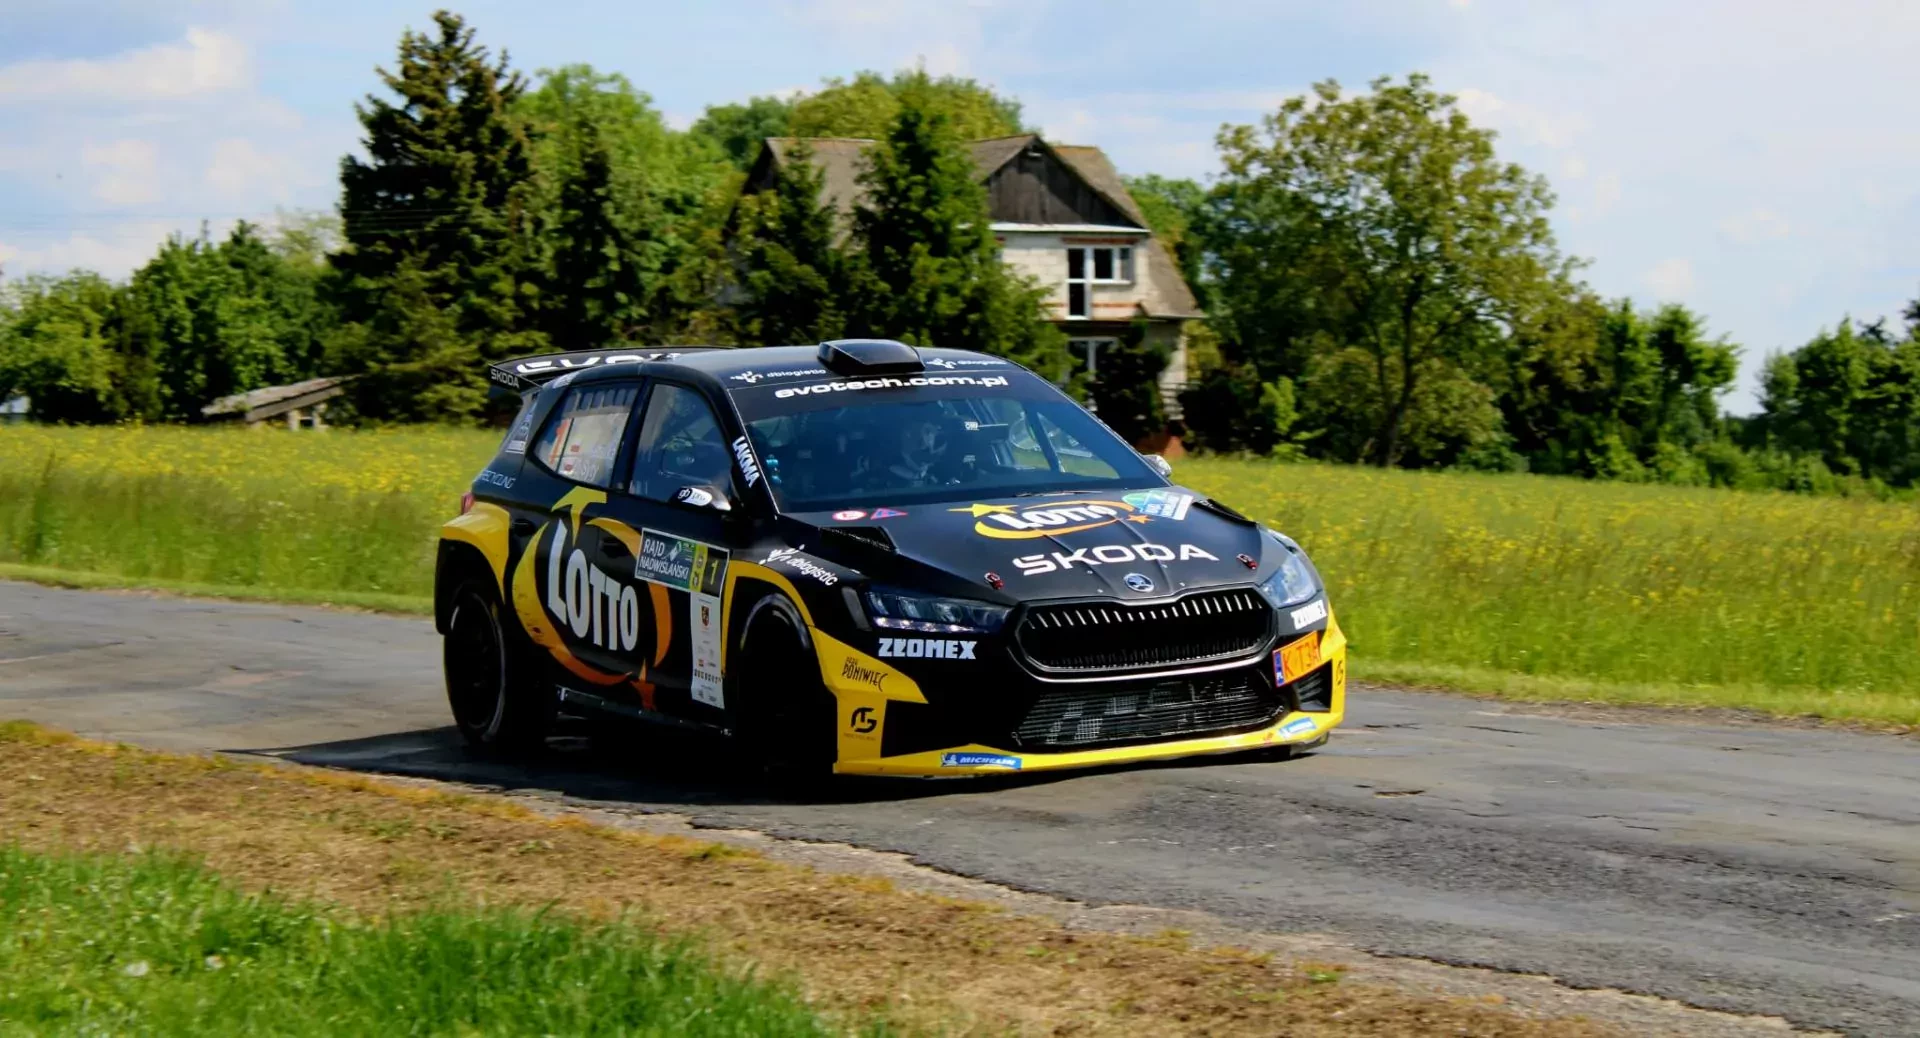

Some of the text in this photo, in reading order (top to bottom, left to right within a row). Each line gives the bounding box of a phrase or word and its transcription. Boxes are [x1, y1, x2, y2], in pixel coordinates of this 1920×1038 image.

[775, 376, 1009, 398] evotech.com.pl
[732, 435, 761, 488] LAKMA
[988, 505, 1118, 529] LOTTO
[643, 538, 666, 557] RAJD
[710, 559, 719, 585] 1
[786, 556, 839, 586] dblogistic
[547, 518, 639, 652] LOTTO
[877, 637, 978, 660] ZŁOMEX
